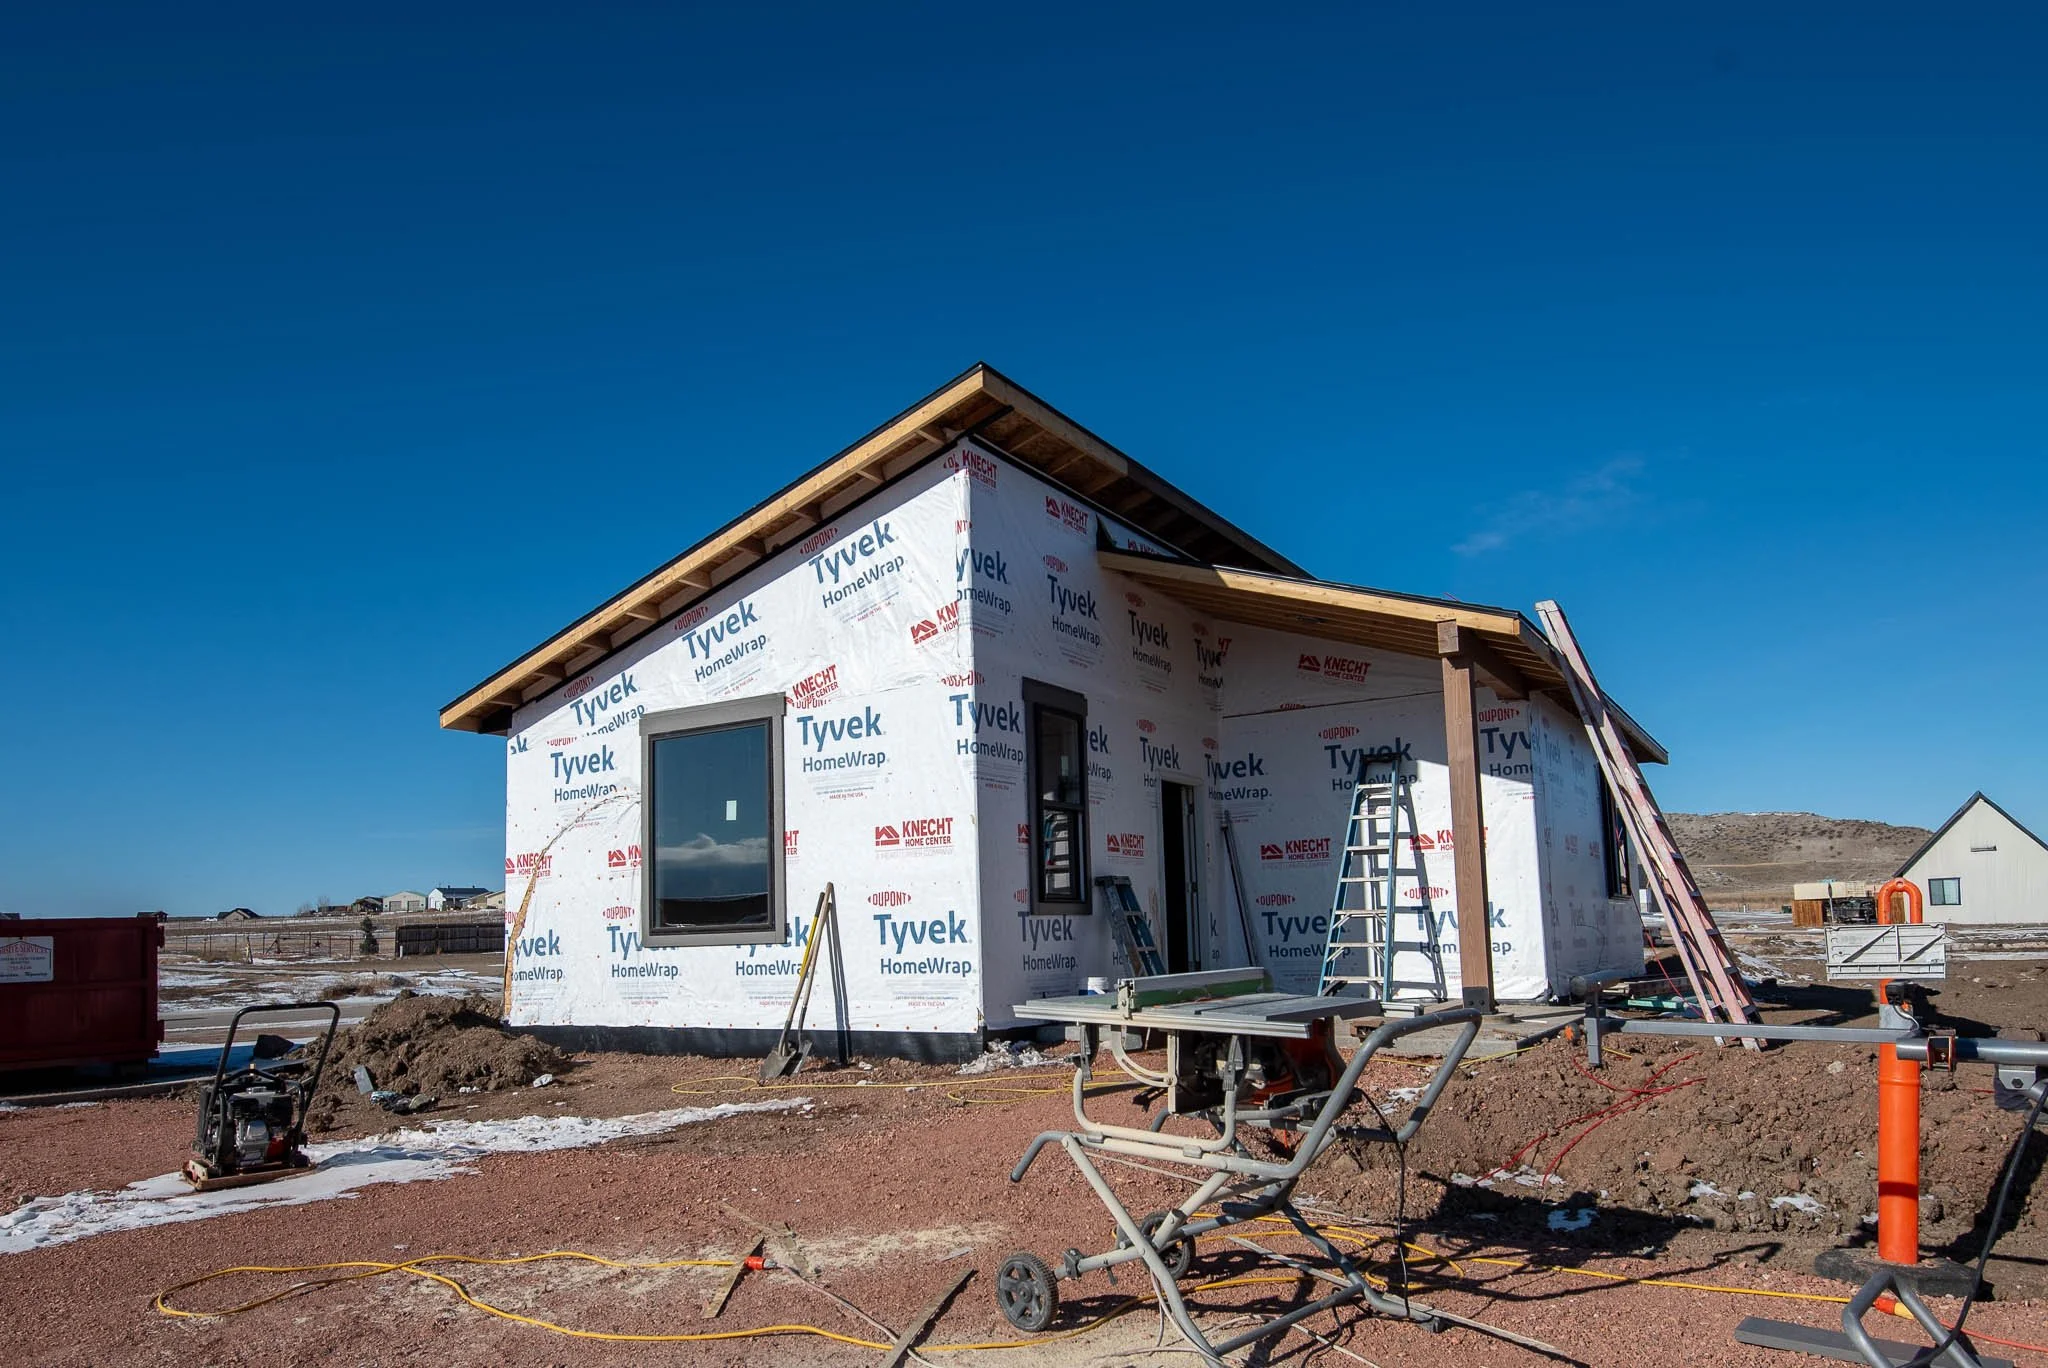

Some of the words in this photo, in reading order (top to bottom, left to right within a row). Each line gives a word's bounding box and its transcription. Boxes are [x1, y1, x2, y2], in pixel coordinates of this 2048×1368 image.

[962, 450, 997, 478] KNECHT
[1061, 501, 1088, 524] KNECHT
[804, 529, 834, 554] DUPONT
[808, 519, 895, 584] Tyvek
[956, 548, 1008, 584] yvek
[822, 555, 905, 608] HomeWrap
[957, 587, 1011, 615] omeWrap
[1048, 574, 1098, 620] Tyvek
[678, 607, 705, 630] DUPONT
[682, 600, 758, 660] Tyvek
[1128, 610, 1169, 649] Tyvek
[1052, 615, 1100, 648] HomeWrap
[694, 634, 768, 682] HomeWrap
[1132, 647, 1172, 674] HomeWrap
[1324, 656, 1372, 675] KNECHT
[566, 677, 592, 699] DUPONT
[792, 664, 837, 699] KNECHT
[815, 681, 839, 698] CENTER
[570, 672, 638, 726] Tyvek
[949, 693, 1021, 734] Tyvek
[1479, 708, 1514, 722] DUPONT
[797, 706, 882, 752] Tyvek
[1323, 727, 1356, 740] DUPONT
[803, 750, 886, 772] HomeWrap
[957, 738, 1024, 764] HomeWrap
[1140, 736, 1181, 772] Tyvek
[550, 744, 615, 784] Tyvek
[1205, 752, 1266, 785] Tyvek
[902, 817, 953, 838] KNECHT
[905, 838, 924, 847] HOME
[925, 836, 952, 845] CENTER
[1120, 832, 1144, 850] KNECHT
[1285, 838, 1331, 854] KNECHT
[517, 853, 552, 871] KNECHT
[1288, 853, 1304, 861] HOME
[1306, 851, 1329, 860] CENTER
[872, 891, 906, 907] DUPONT
[1260, 894, 1291, 906] DUPONT
[1409, 886, 1444, 900] DUPONT
[606, 905, 632, 920] DUPONT
[873, 910, 968, 954] Tyvek
[1018, 911, 1073, 951] Tyvek
[1262, 909, 1346, 942] Tyve
[513, 966, 563, 982] omeWrap
[611, 961, 679, 980] HomeWrap
[735, 960, 808, 977] HomeWra
[880, 957, 972, 978] HomeWrap
[1023, 953, 1076, 971] HomeWrap
